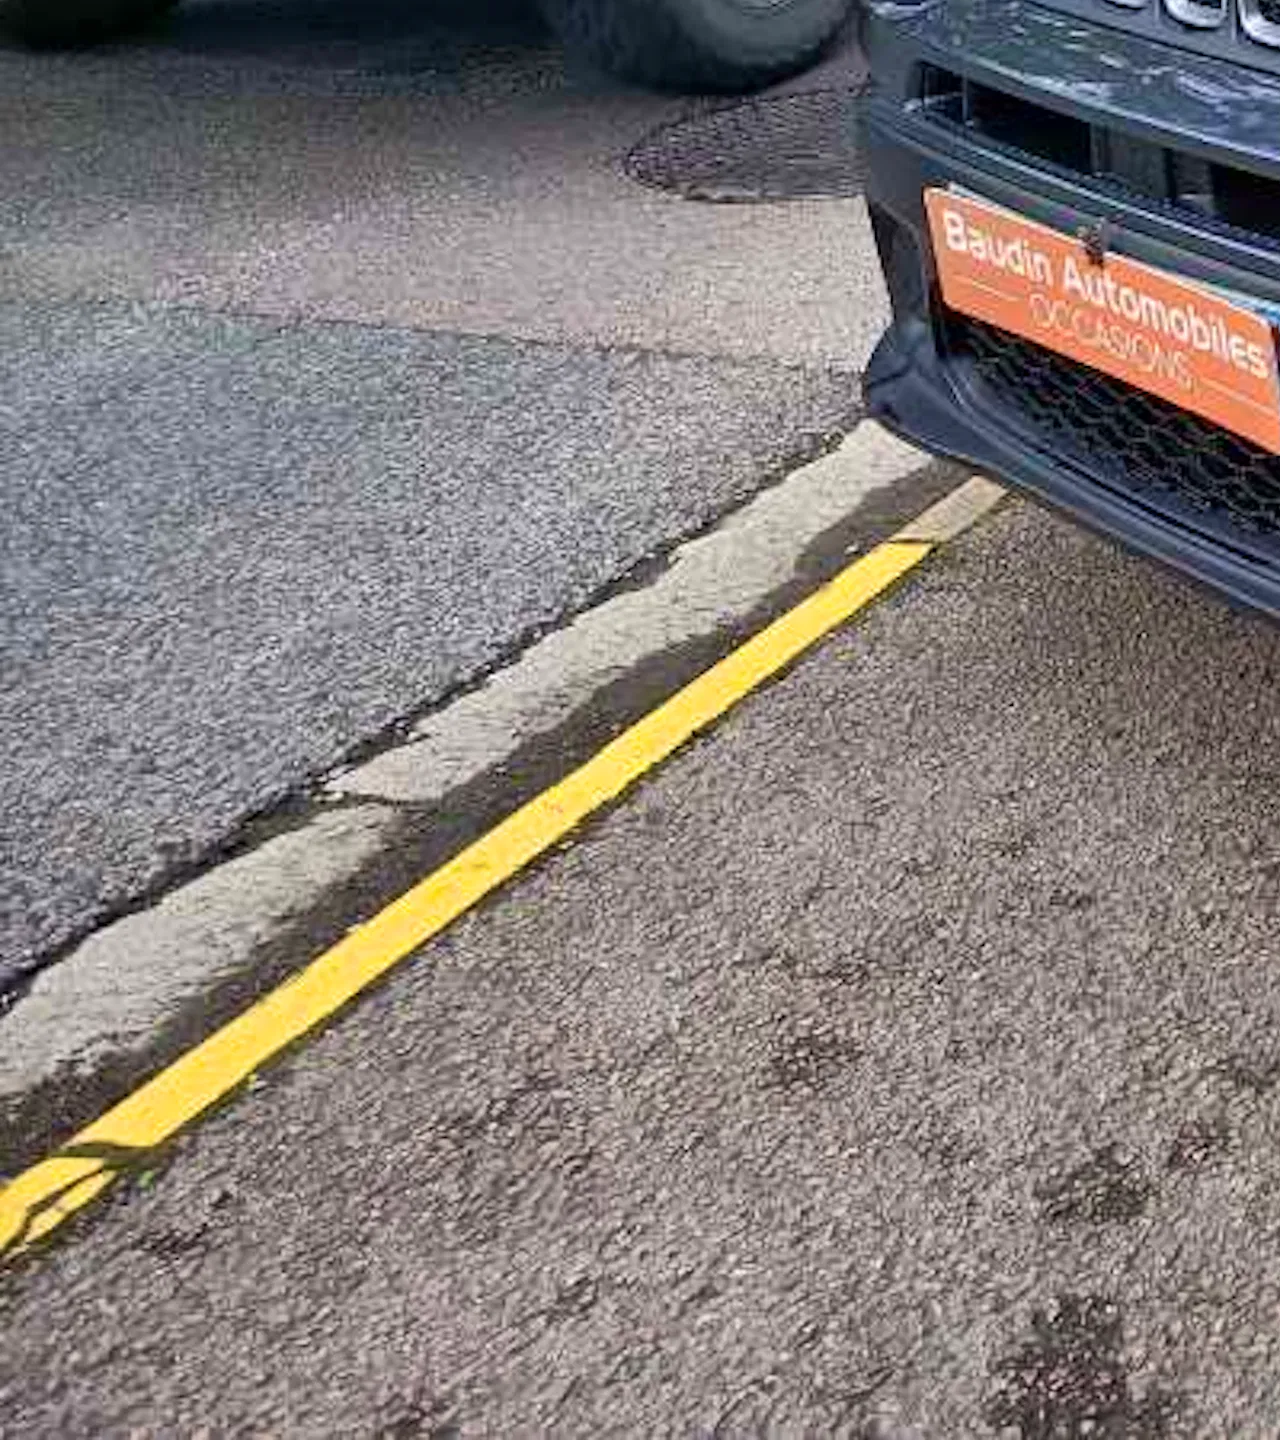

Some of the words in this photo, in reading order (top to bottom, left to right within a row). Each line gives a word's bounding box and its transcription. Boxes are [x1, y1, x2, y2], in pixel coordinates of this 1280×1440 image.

[943, 210, 1054, 288] Baudin
[1063, 258, 1270, 380] Automobiles
[1028, 293, 1195, 393] OCCASIONS
